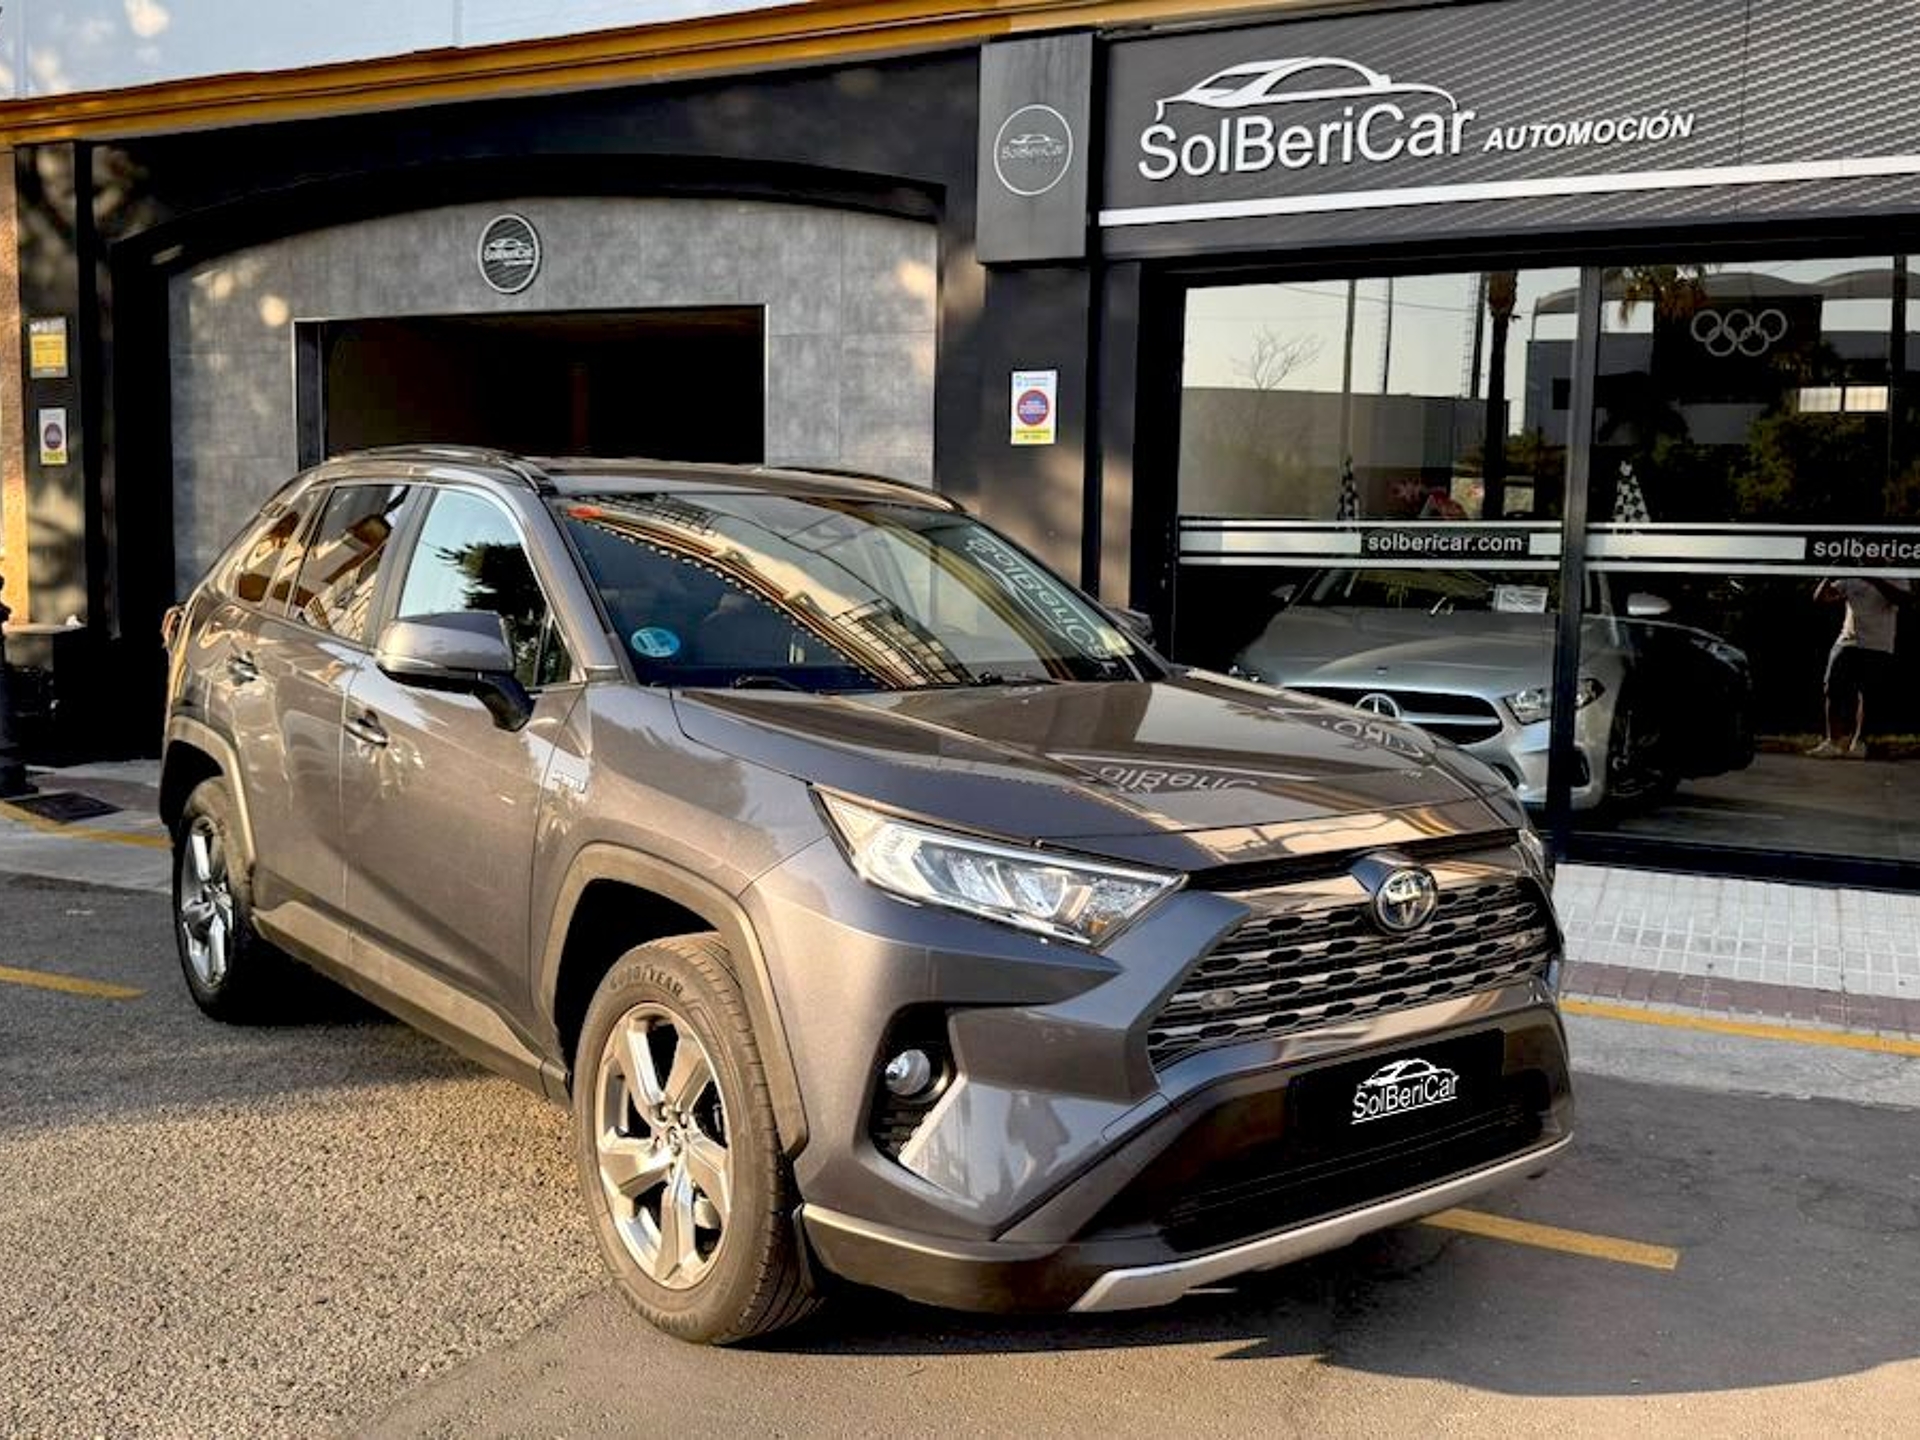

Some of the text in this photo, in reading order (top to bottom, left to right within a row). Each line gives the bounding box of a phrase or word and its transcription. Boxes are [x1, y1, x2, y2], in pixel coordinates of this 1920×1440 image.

[1138, 103, 1694, 181] SolBeriCar AUTOMOCIÓN
[1367, 533, 1522, 552] solbericar.com
[1352, 1074, 1460, 1118] SolBeriCar
